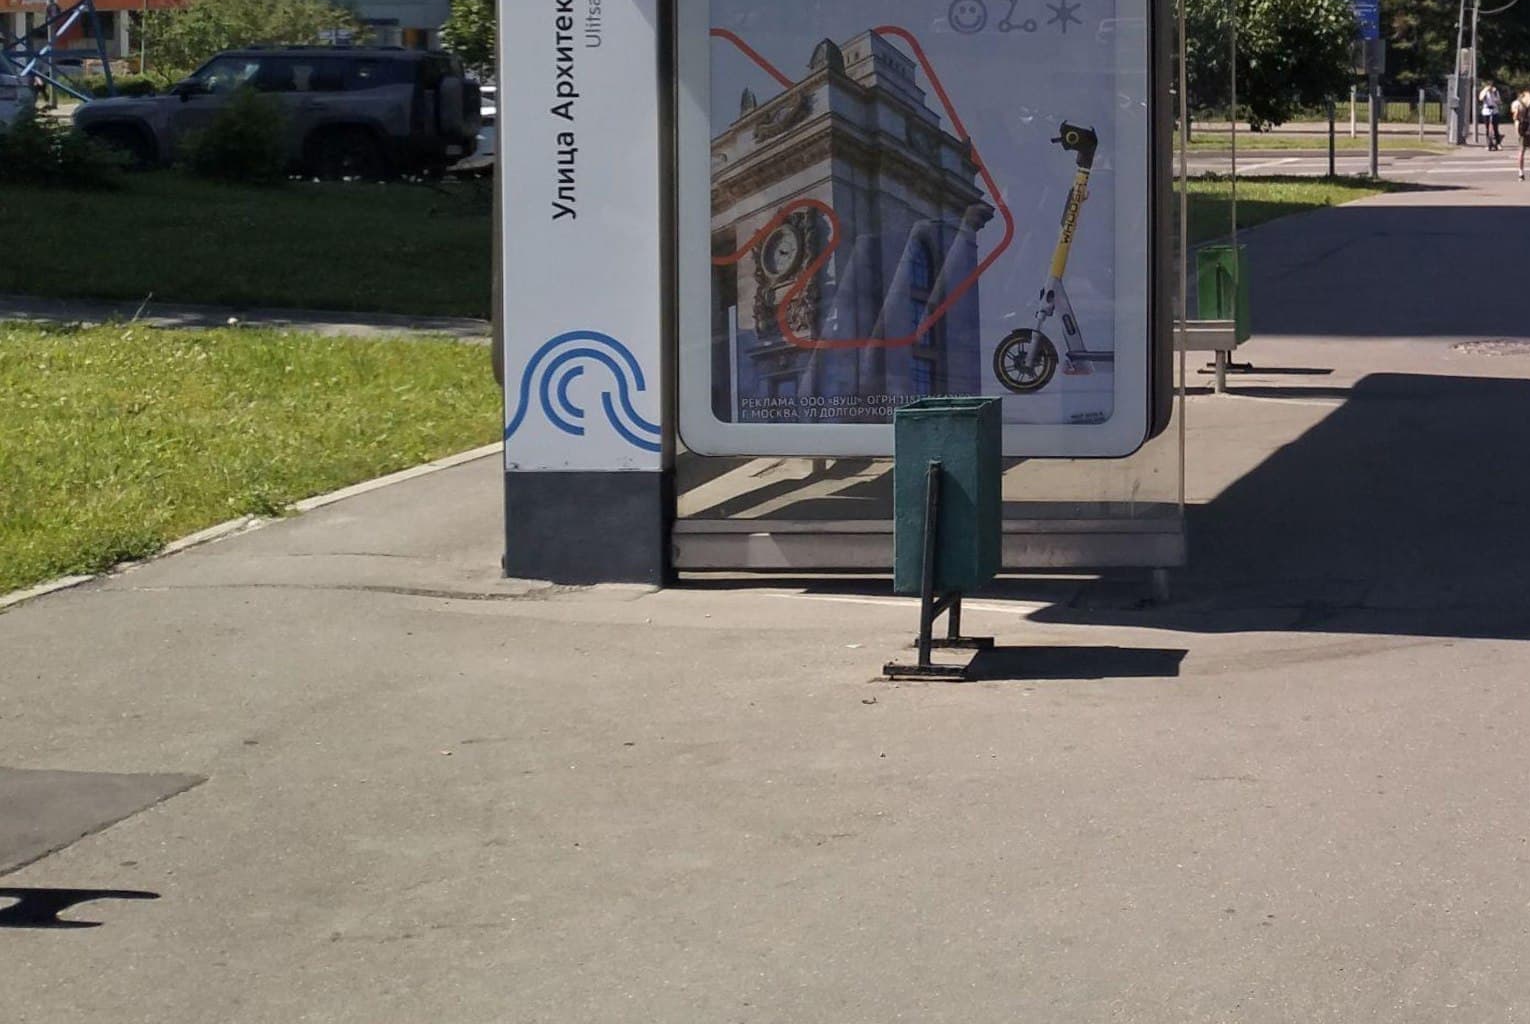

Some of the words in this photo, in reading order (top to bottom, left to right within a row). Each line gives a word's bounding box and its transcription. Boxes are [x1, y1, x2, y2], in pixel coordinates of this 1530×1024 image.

[552, 132, 578, 220] Улица
[800, 396, 825, 407] ООО
[867, 394, 896, 405] ОГРН
[820, 406, 895, 418] ДОЛГОРУКОВ
